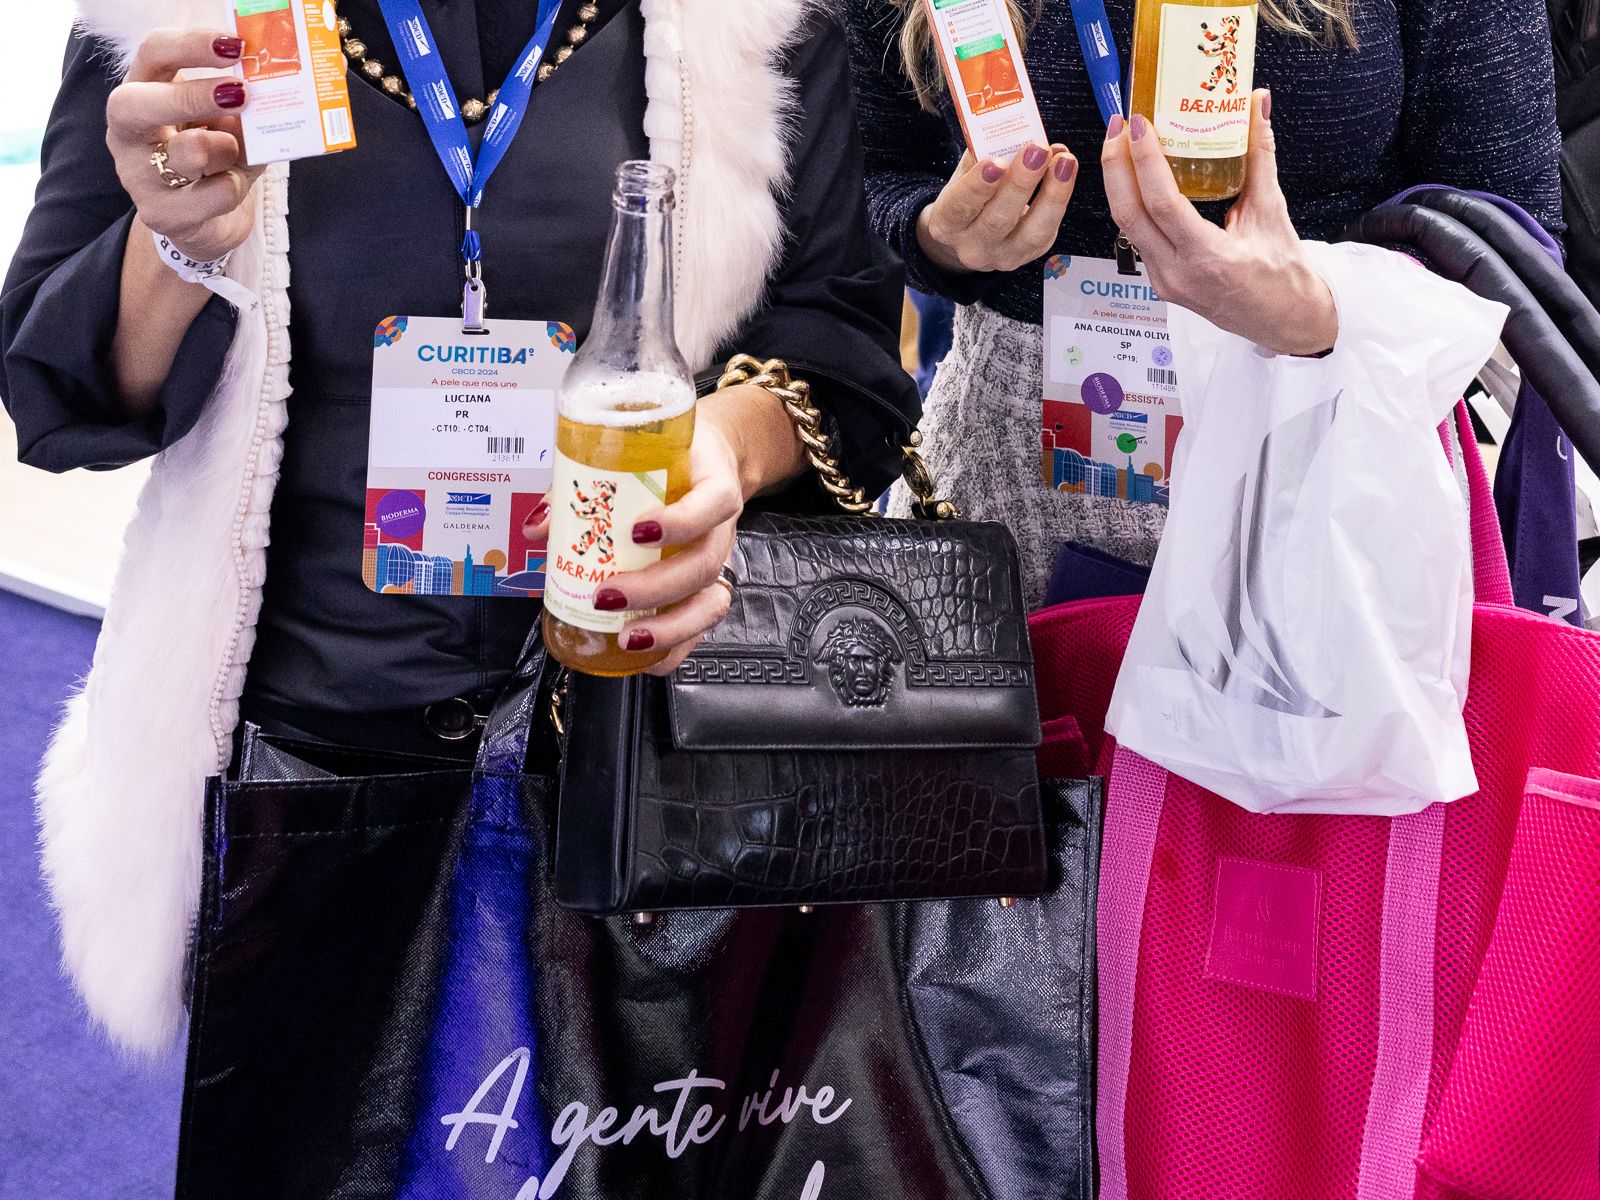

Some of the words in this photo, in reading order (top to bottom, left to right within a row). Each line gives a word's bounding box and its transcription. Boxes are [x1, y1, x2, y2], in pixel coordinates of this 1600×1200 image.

[1177, 138, 1190, 149] ml
[1100, 310, 1119, 319] pele
[1120, 313, 1136, 321] que
[1074, 323, 1092, 331] ANA
[1095, 325, 1142, 337] CAROLINA
[1120, 341, 1132, 350] SP
[477, 368, 498, 376] 2024
[431, 378, 438, 386] A
[440, 378, 460, 388] pele
[462, 380, 480, 389] que
[482, 380, 499, 388] nos
[444, 394, 491, 403] LUCIANA
[455, 410, 470, 419] PR
[428, 471, 511, 483] CONGRESSISTA
[381, 507, 419, 521] BIODERMA
[441, 1047, 530, 1163] A
[538, 1069, 726, 1199] gente
[739, 1069, 853, 1132] vive
